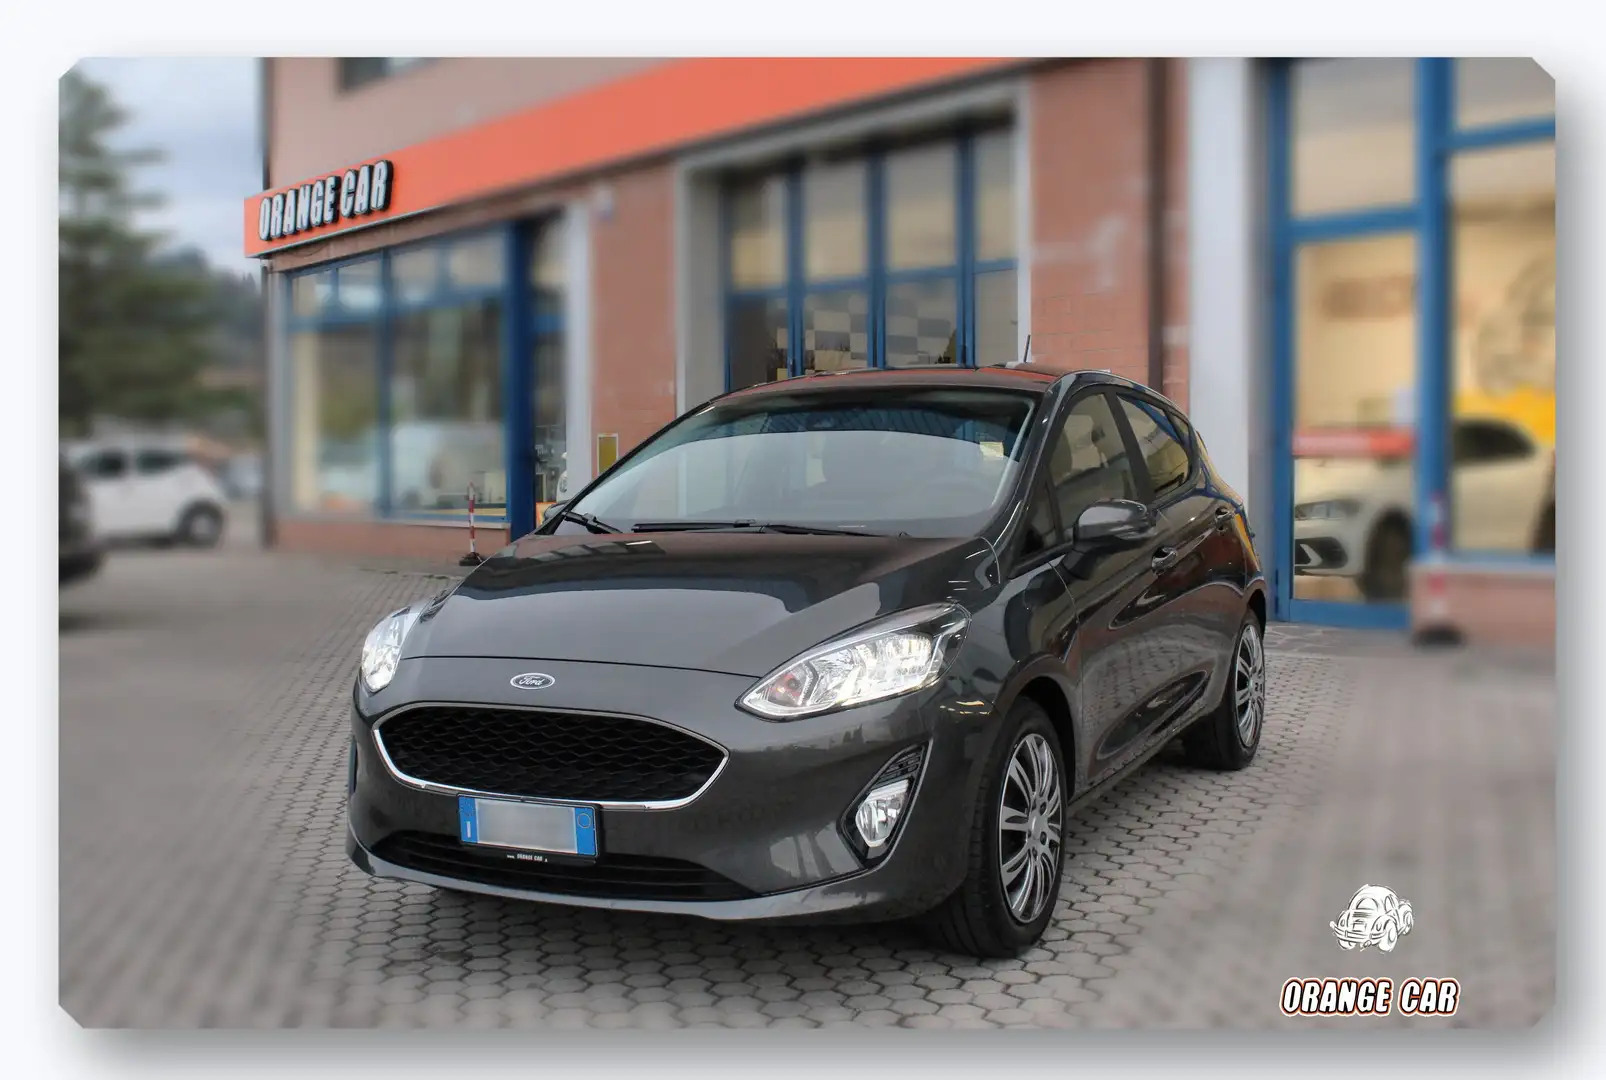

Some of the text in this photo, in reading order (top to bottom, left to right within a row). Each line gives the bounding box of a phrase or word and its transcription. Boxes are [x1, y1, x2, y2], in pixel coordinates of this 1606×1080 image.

[259, 160, 393, 241] ORANGE CAR
[518, 675, 546, 686] Ford
